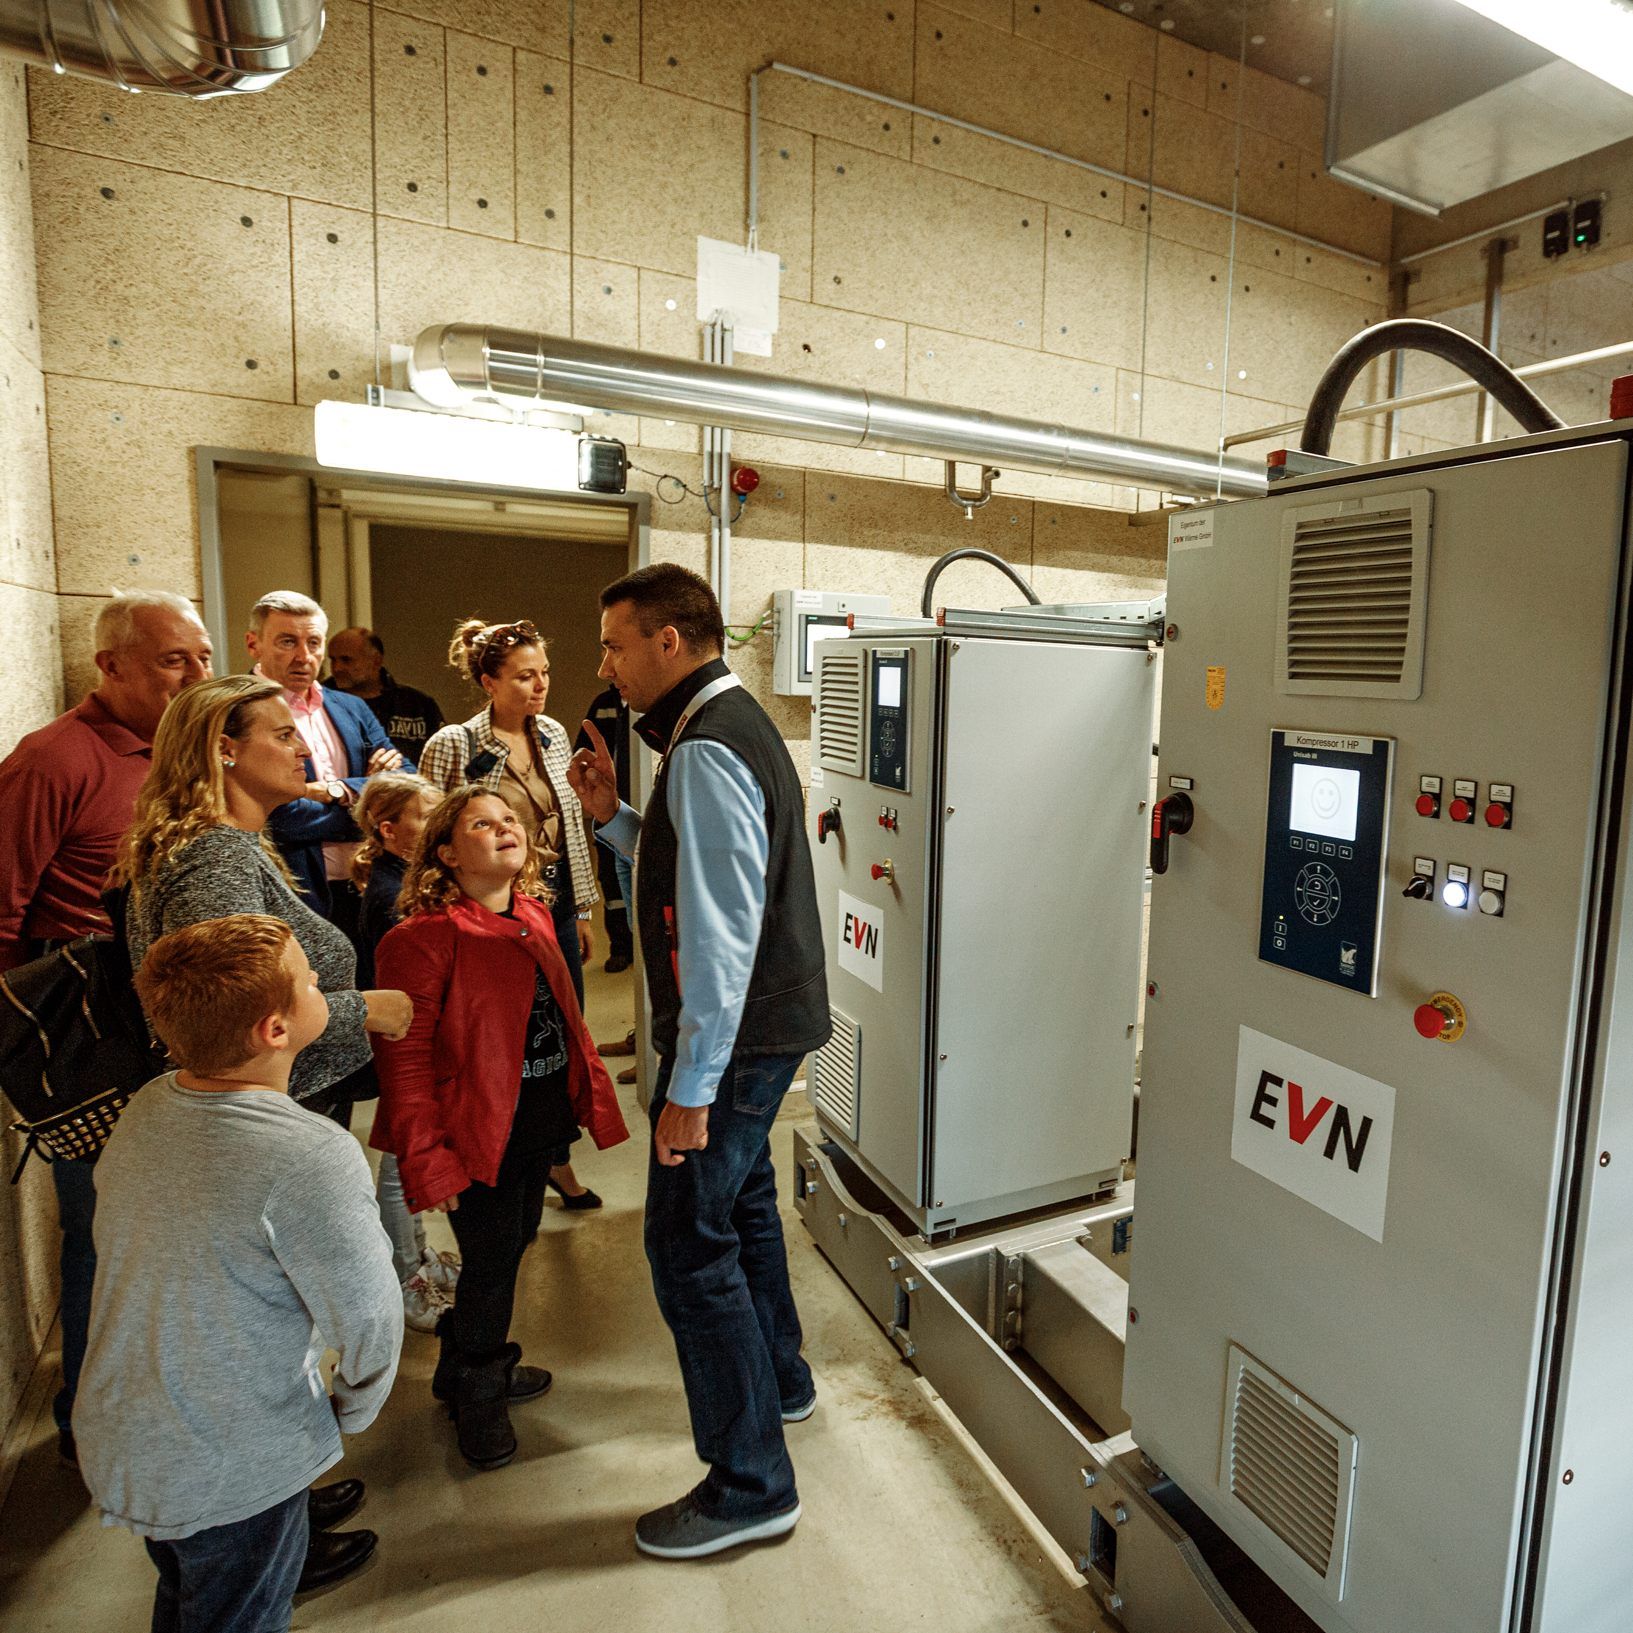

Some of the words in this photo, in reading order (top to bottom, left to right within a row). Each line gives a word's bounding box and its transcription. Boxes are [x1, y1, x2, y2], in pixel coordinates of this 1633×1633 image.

[1296, 736, 1338, 748] Kompressor
[1340, 740, 1345, 748] 1
[1347, 741, 1359, 749] HP
[843, 912, 879, 959] EVN
[1250, 1069, 1373, 1173] EVN
